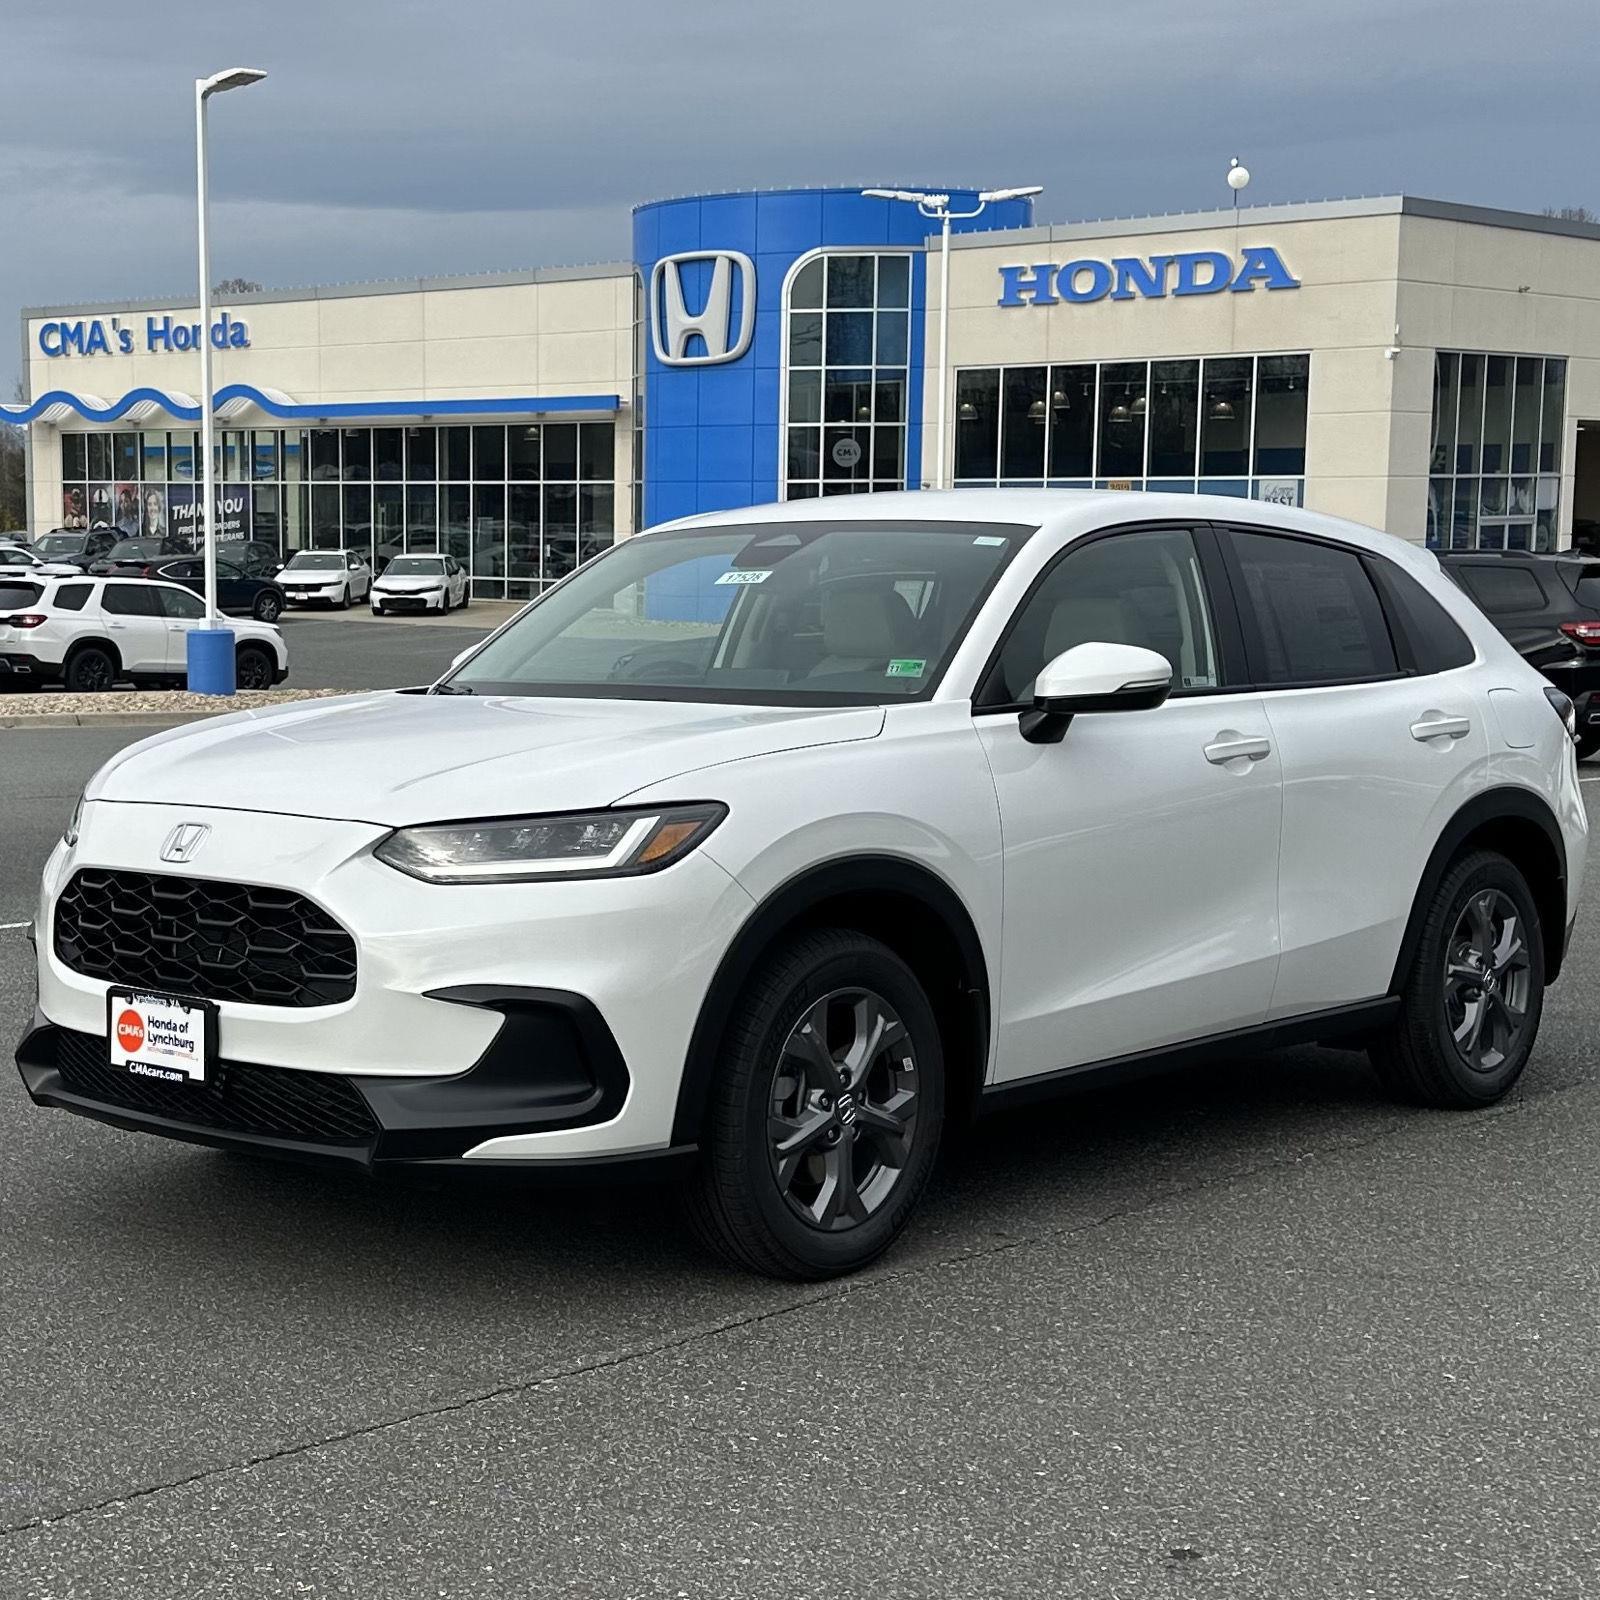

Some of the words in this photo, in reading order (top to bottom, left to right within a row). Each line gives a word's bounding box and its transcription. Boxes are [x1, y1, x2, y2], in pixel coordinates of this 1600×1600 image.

[998, 247, 1301, 307] HONDA
[39, 317, 134, 356] CMA's
[172, 503, 205, 520] THAN
[217, 498, 243, 514] YOU
[147, 1015, 178, 1032] Honda
[178, 1021, 189, 1034] of
[148, 1031, 194, 1053] Lynchburg
[129, 1062, 183, 1082] CMAcars.com
